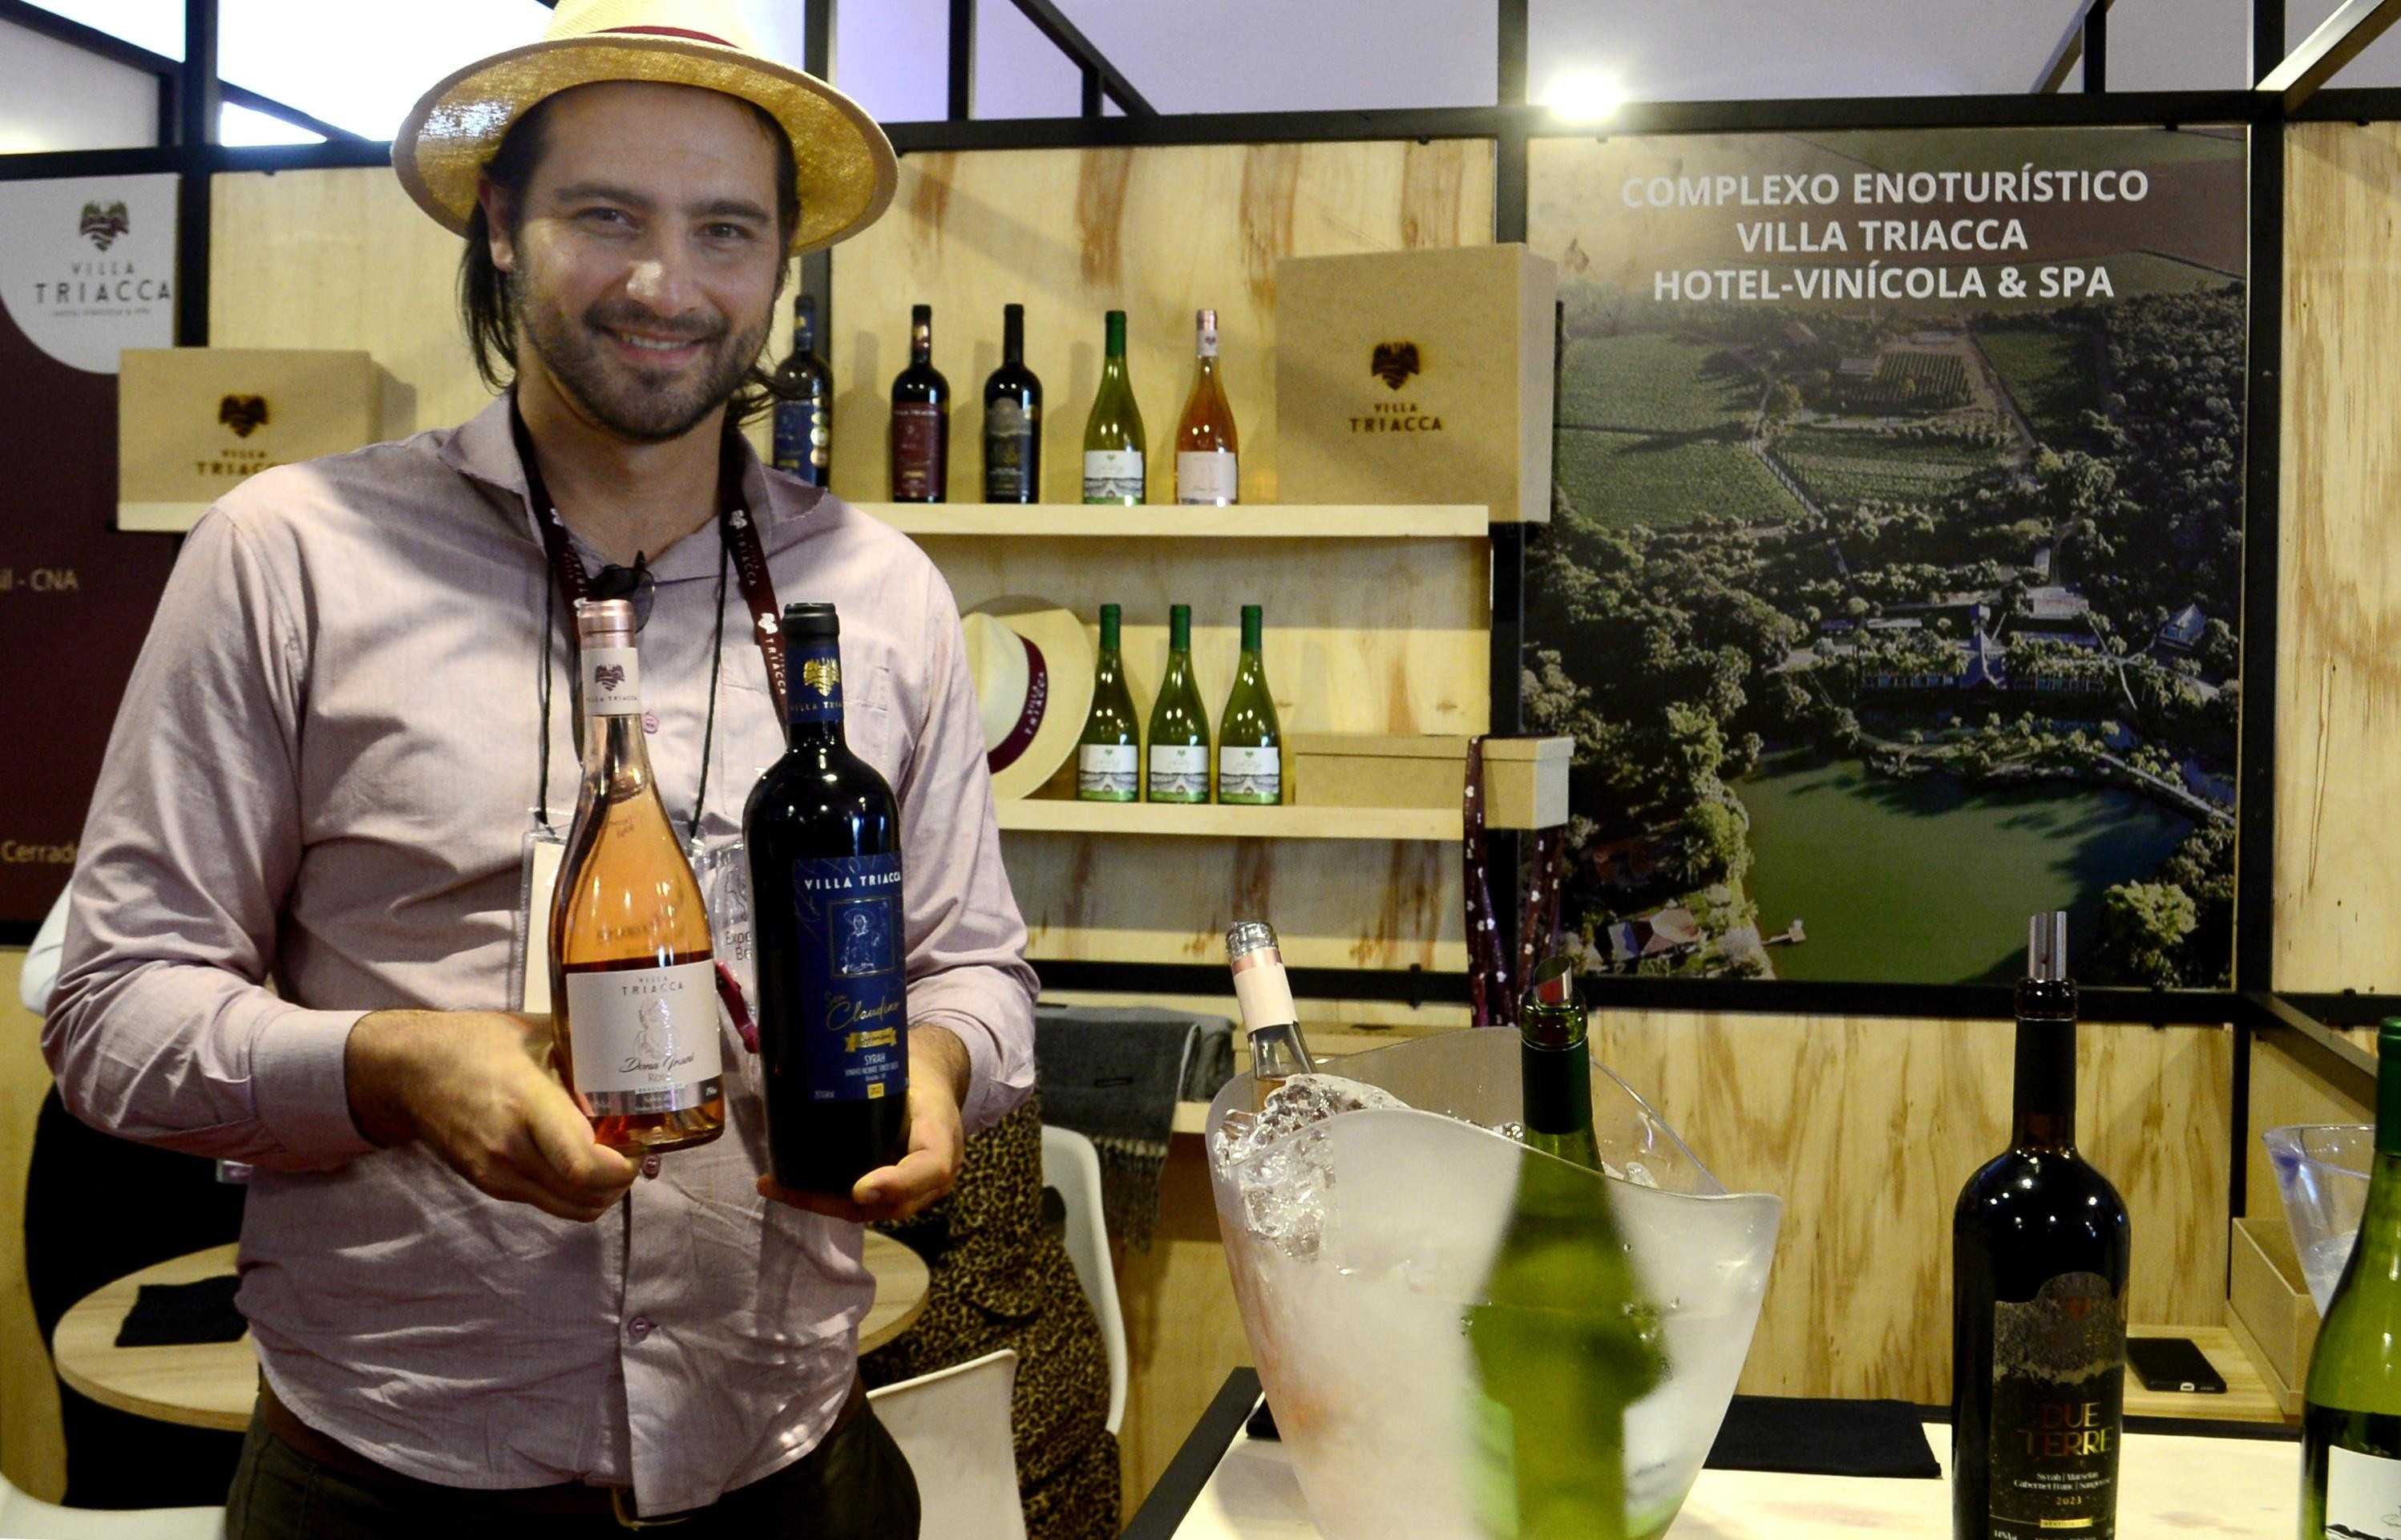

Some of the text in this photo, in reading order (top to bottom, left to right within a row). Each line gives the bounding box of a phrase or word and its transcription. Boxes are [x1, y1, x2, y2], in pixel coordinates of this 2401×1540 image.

[1622, 163, 2148, 207] COMPLEXO ENOTURÍSTICO
[1736, 219, 2029, 253] VILLA TRIACCA
[72, 261, 135, 276] VILLA
[1655, 260, 2115, 301] HOTEL-VINÍCOLA & SPA
[35, 280, 171, 304] TRIACCA
[1374, 403, 1417, 413] VILLA
[1349, 416, 1442, 432] TRIACCA
[30, 568, 79, 592] CNA
[765, 638, 786, 694] TRIACCA
[1, 839, 78, 864] Cerrad
[804, 876, 852, 891] VILLA
[622, 981, 683, 996] TRIACCA
[2043, 1401, 2100, 1429] DUE
[2015, 1426, 2113, 1457] TERRE
